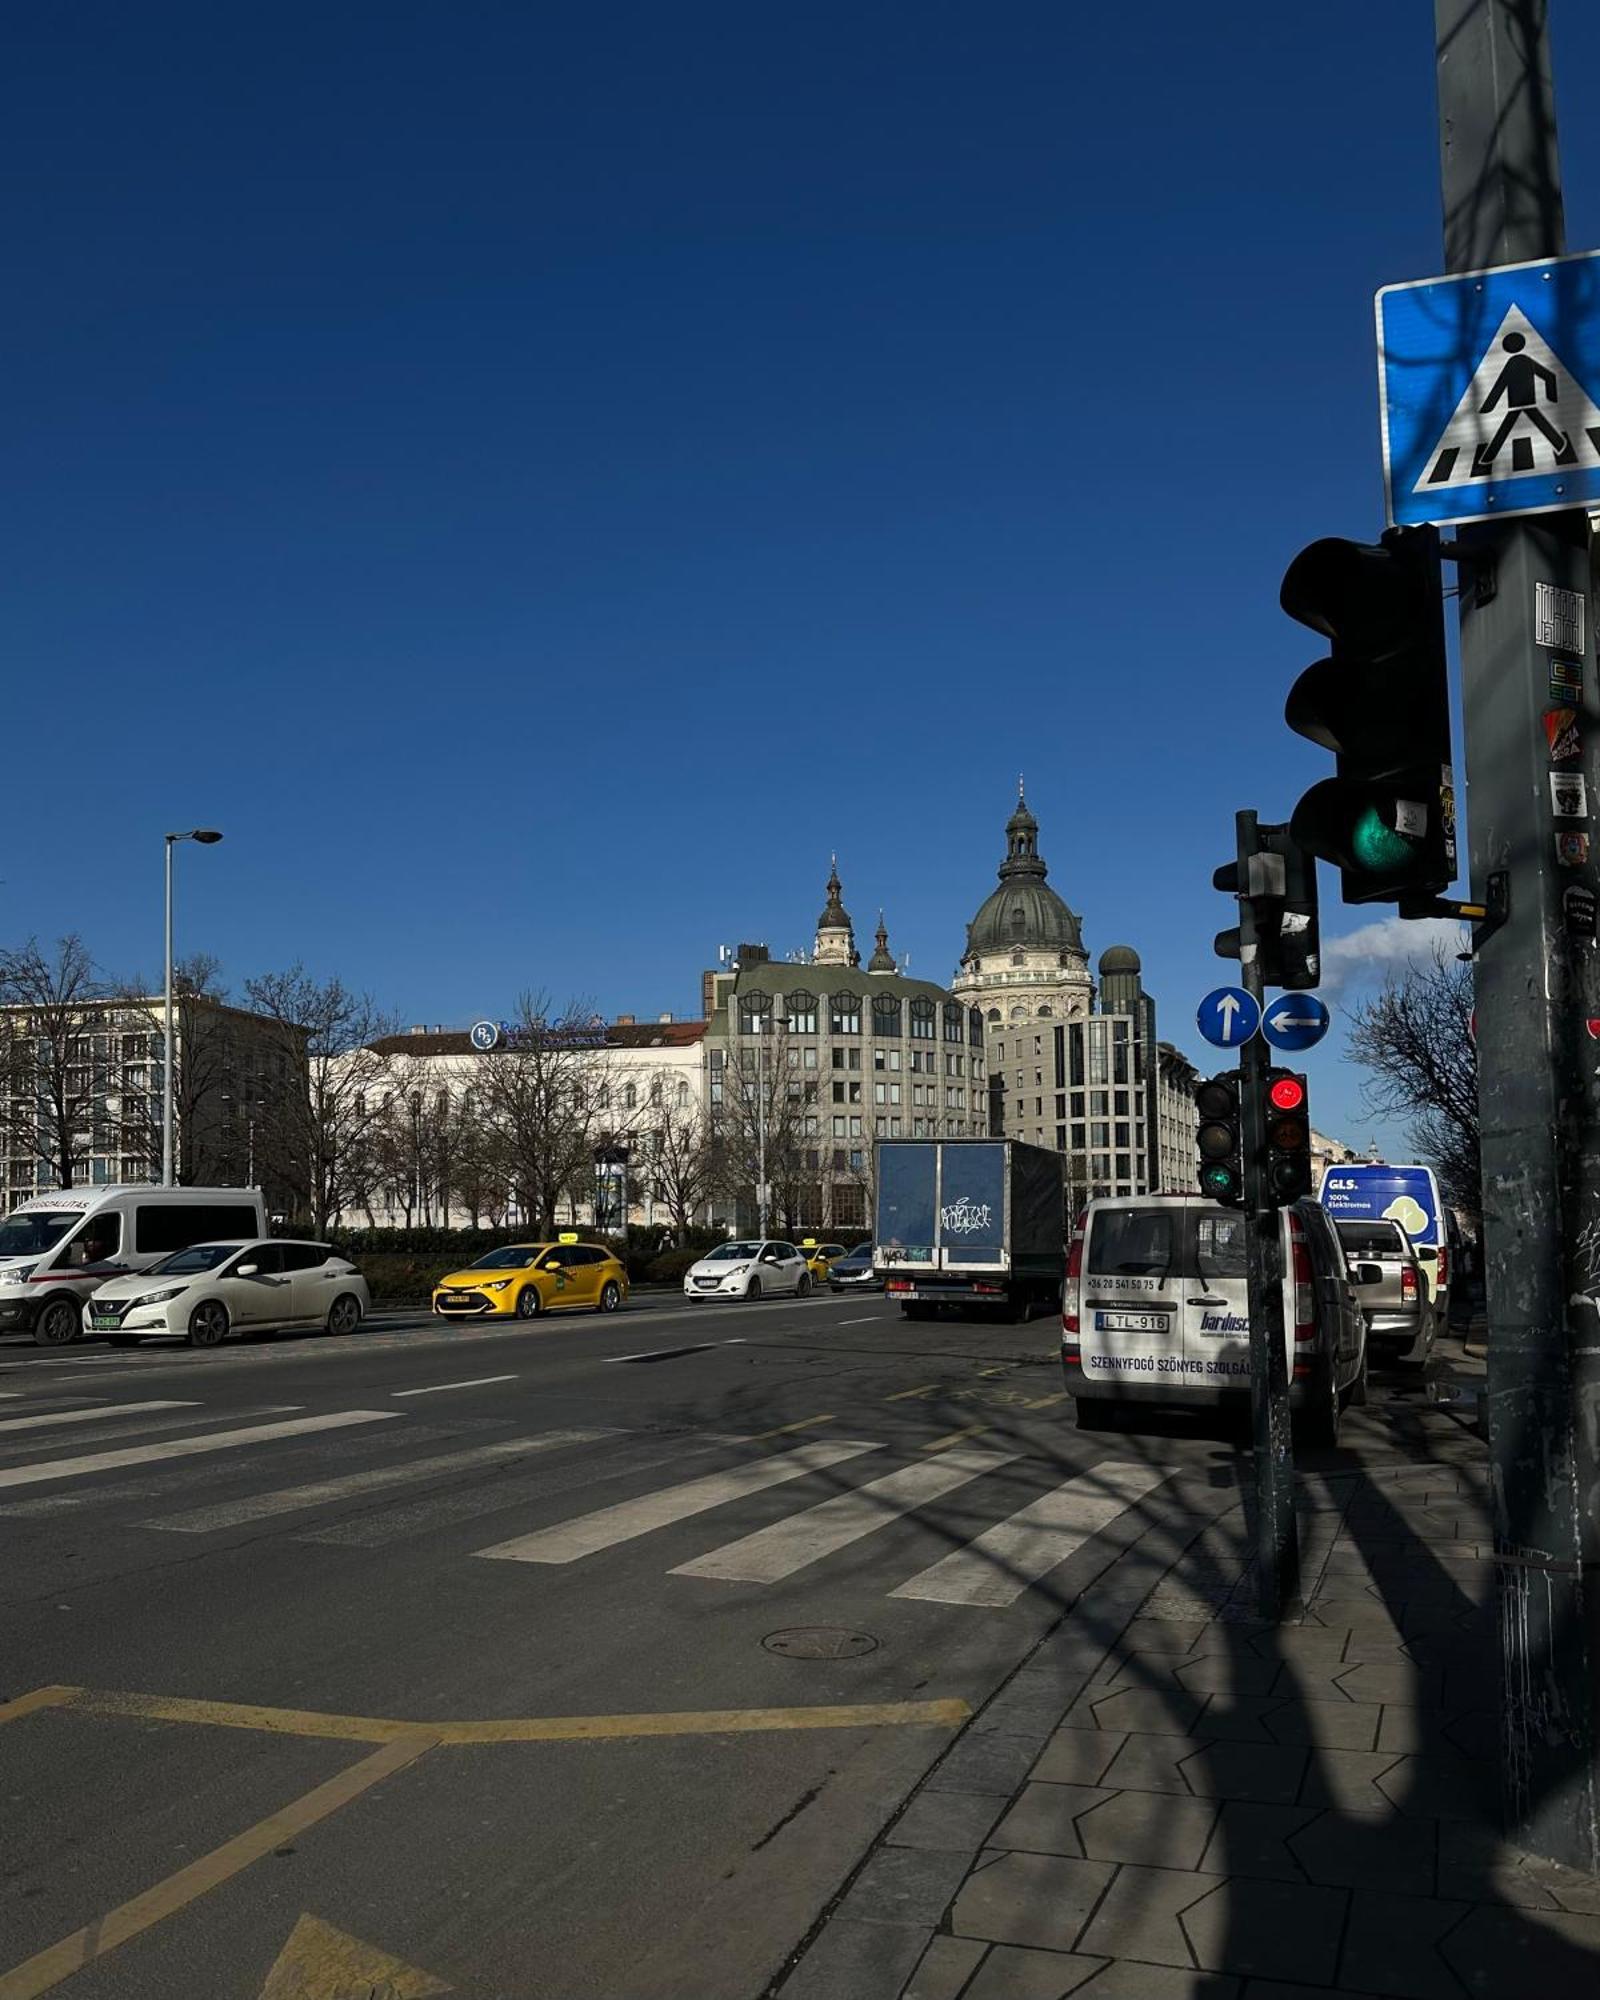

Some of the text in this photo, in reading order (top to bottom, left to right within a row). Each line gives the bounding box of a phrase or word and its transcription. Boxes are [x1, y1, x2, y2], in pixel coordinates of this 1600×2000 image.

[1088, 1279, 1154, 1290] +36 20 541 50 75
[1105, 1315, 1166, 1330] LTL-916
[1200, 1310, 1250, 1332] bardusc
[1091, 1355, 1154, 1371] SZENNYFOGÓ
[1206, 1359, 1254, 1376] SZOLGÁL
